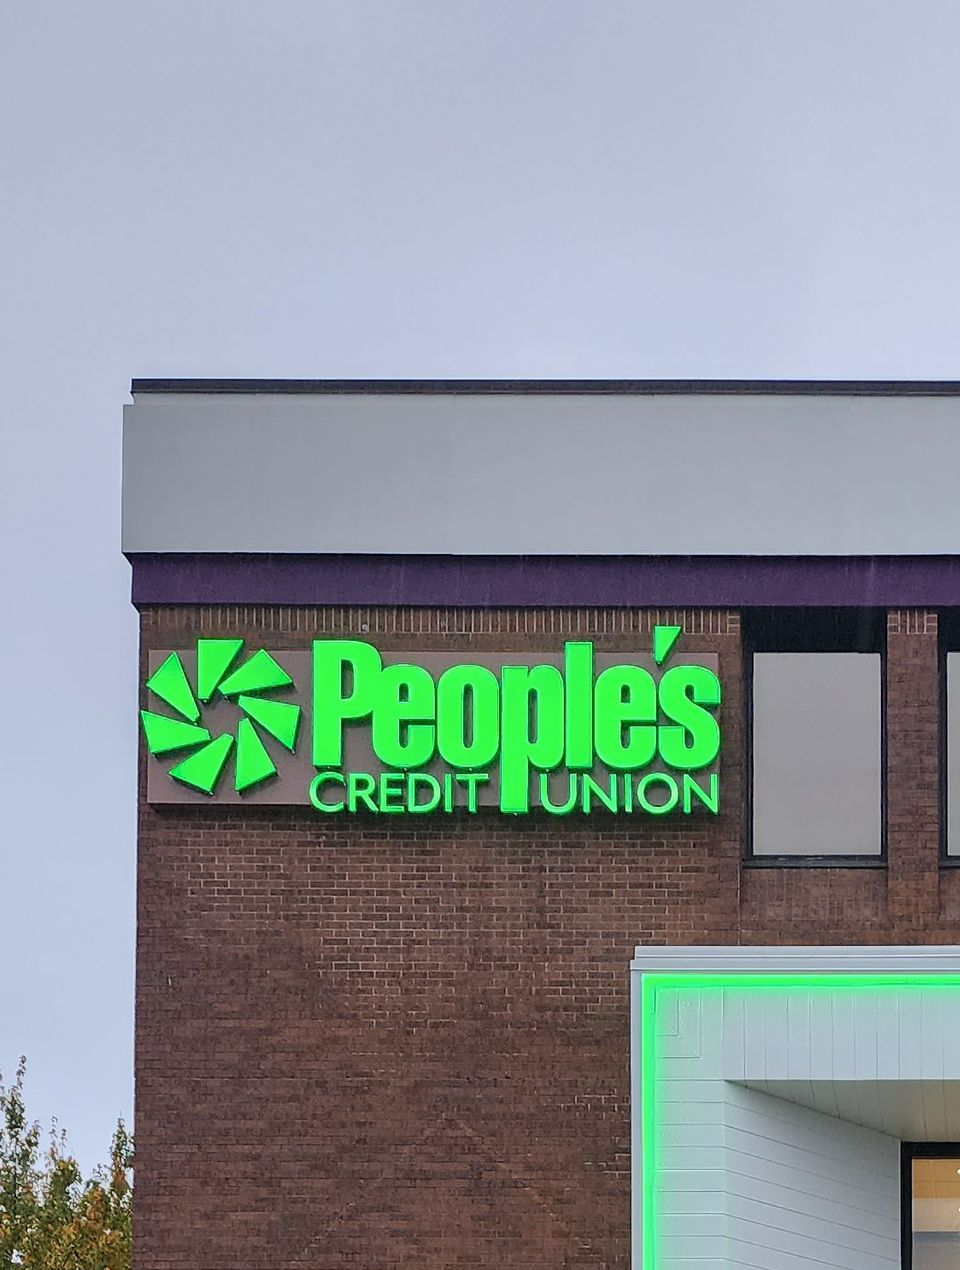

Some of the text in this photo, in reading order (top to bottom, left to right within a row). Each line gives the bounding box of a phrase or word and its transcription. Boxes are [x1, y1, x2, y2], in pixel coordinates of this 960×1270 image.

[312, 626, 721, 815] People's
[309, 771, 719, 816] CREDIT UNION
